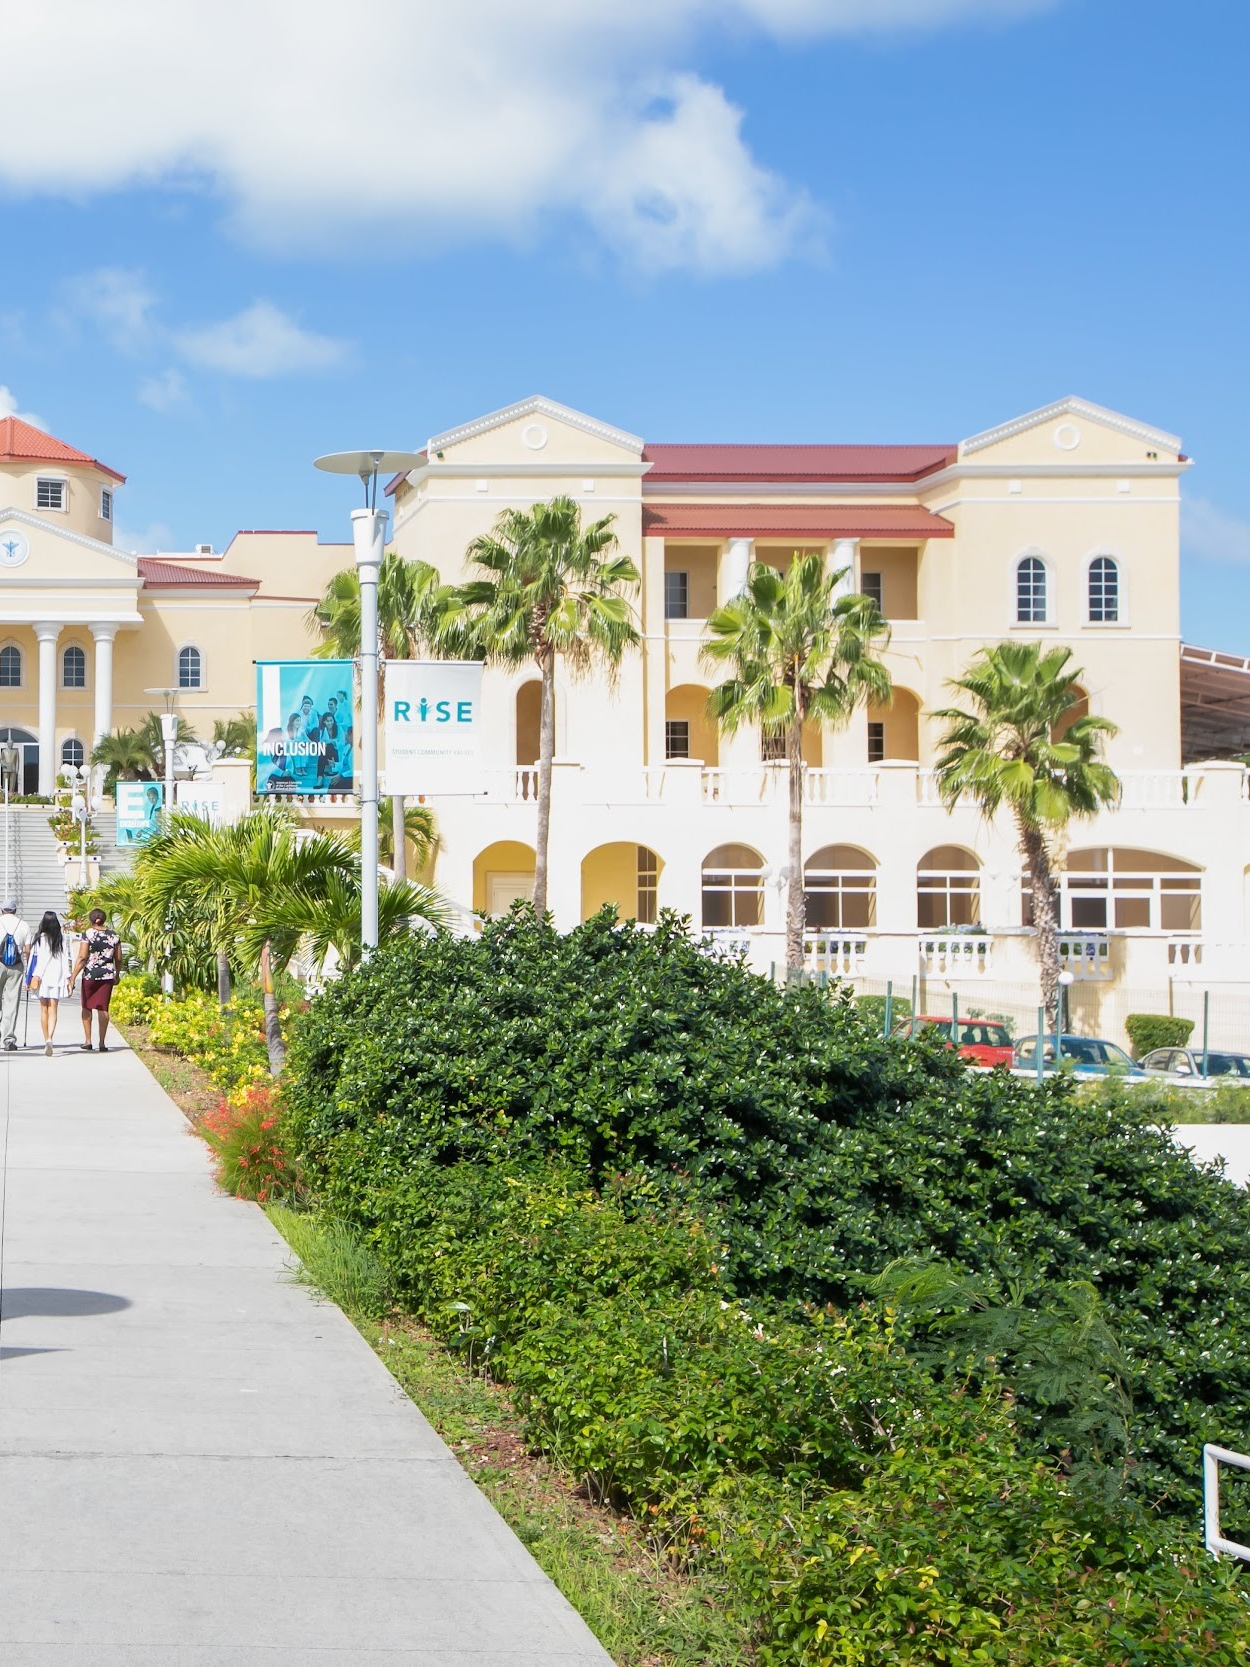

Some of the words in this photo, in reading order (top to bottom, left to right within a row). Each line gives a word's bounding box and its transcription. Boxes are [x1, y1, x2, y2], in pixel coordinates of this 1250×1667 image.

[394, 697, 473, 722] RISE
[262, 741, 326, 757] INCLUSION
[119, 784, 145, 819] E
[181, 799, 219, 811] RISE
